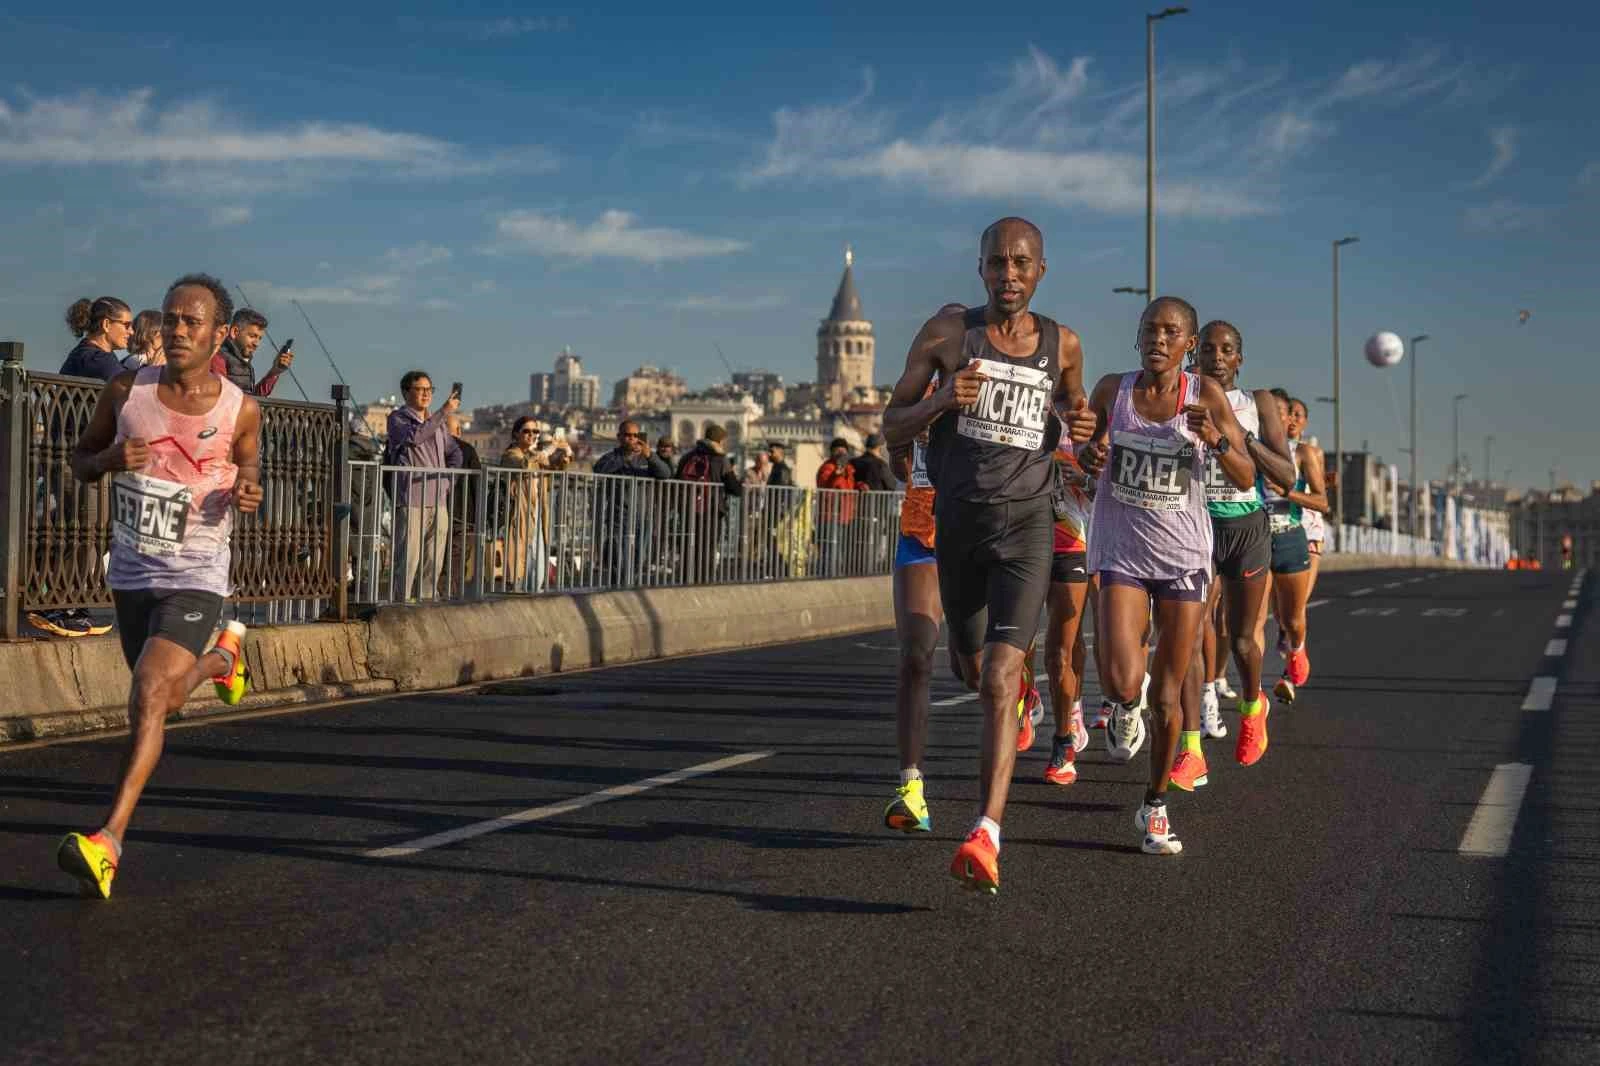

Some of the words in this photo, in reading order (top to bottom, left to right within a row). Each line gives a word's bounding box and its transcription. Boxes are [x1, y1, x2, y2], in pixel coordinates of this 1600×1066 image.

[964, 380, 1047, 430] MICHAEL
[999, 427, 1039, 440] MARATHON
[1024, 439, 1039, 449] 2025
[1118, 449, 1182, 494] RAEL
[1142, 492, 1180, 503] MARATHON
[1166, 503, 1181, 511] 2025
